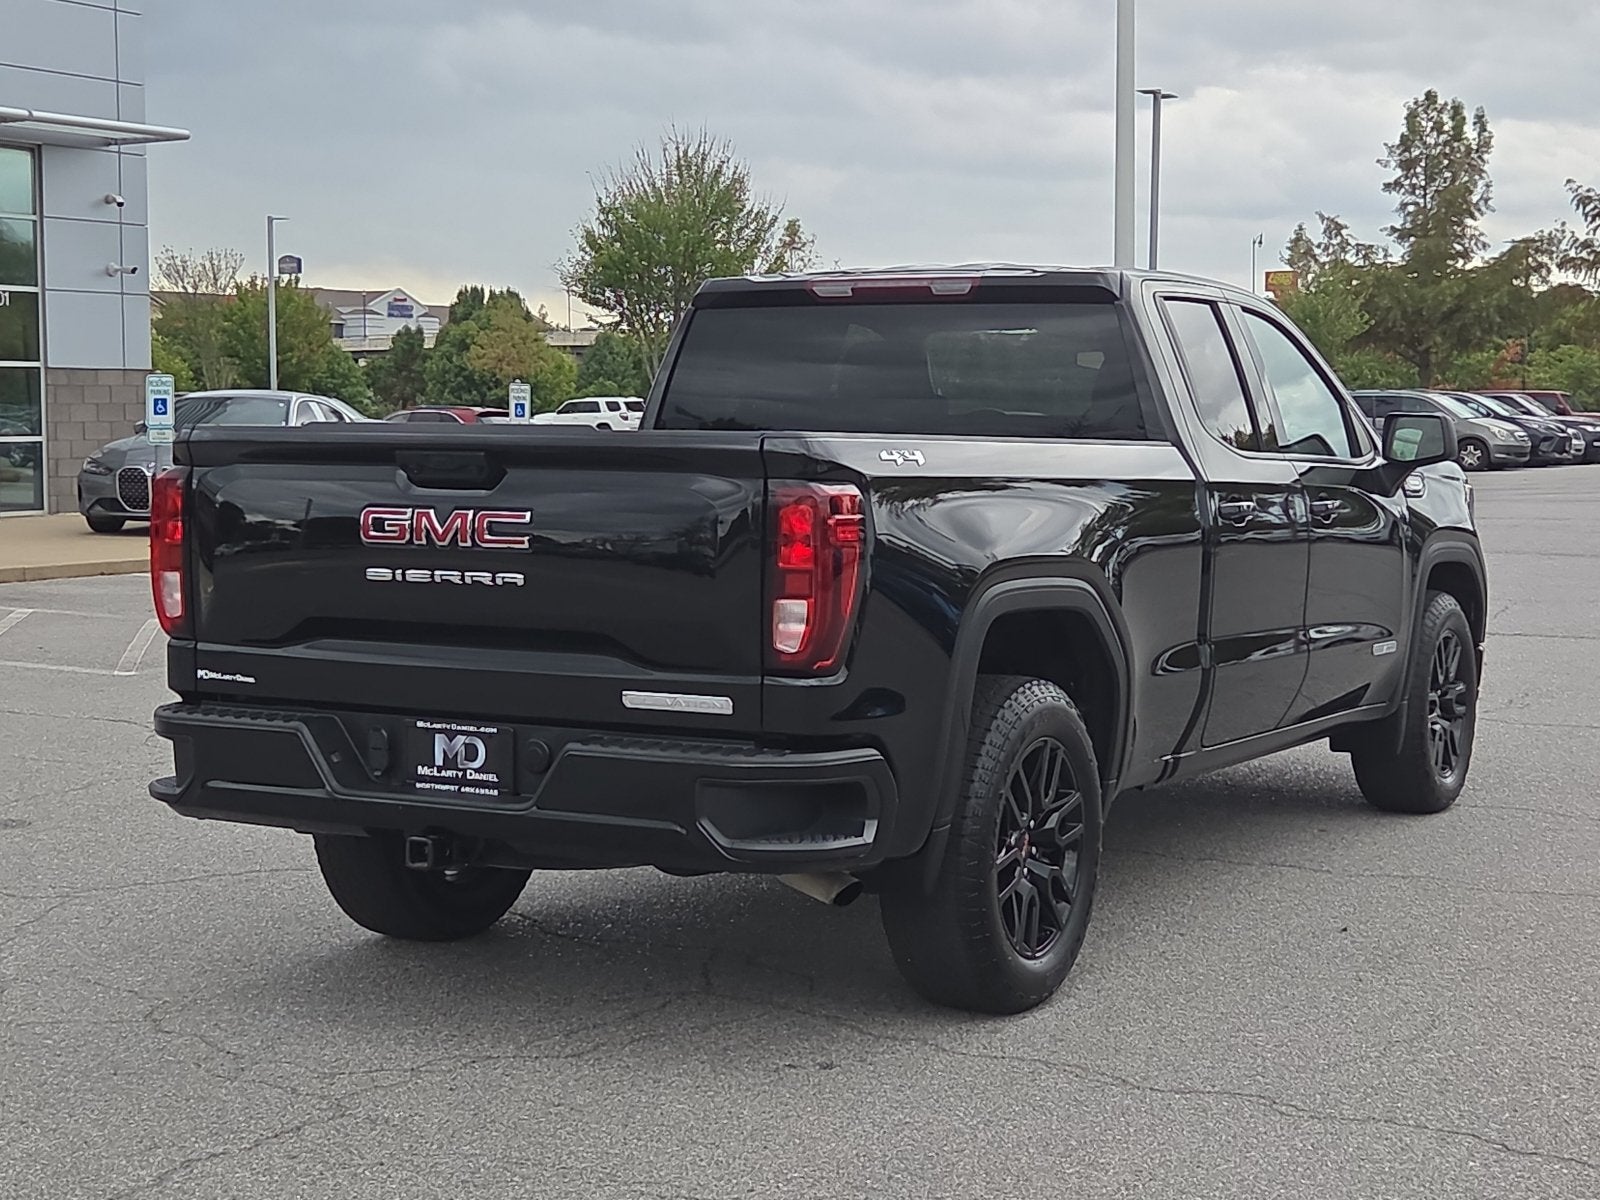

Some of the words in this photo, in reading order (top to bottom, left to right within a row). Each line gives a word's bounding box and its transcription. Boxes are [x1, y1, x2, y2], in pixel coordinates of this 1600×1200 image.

[360, 506, 532, 549] GMC
[365, 567, 525, 587] SIERRA
[434, 733, 486, 769] MD
[466, 769, 500, 782] DANIEL
